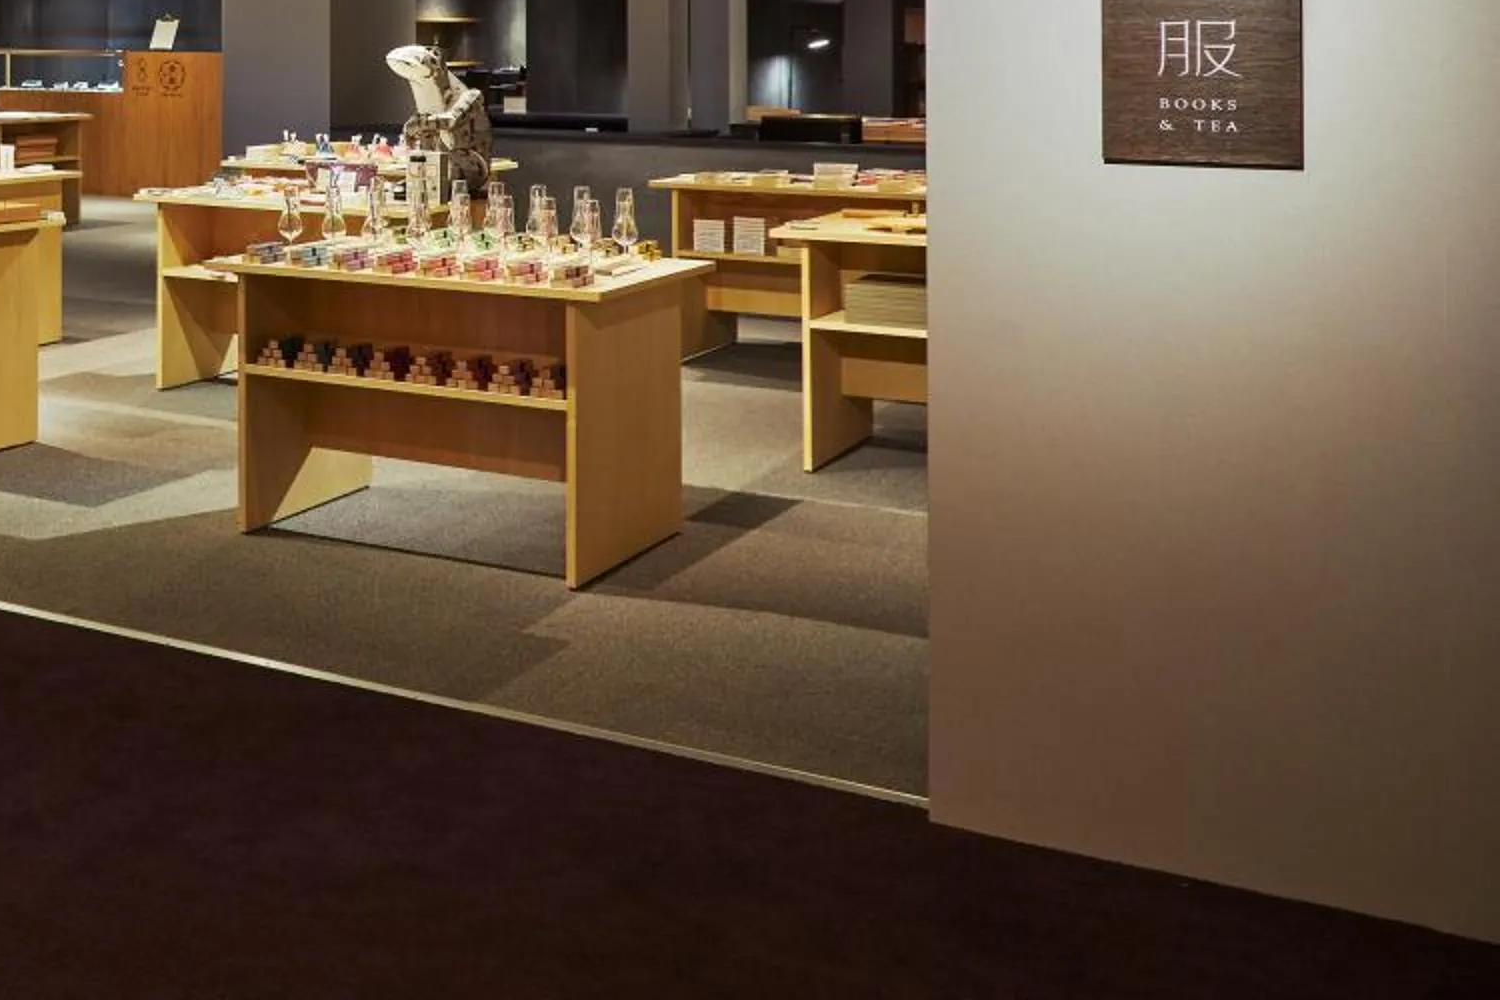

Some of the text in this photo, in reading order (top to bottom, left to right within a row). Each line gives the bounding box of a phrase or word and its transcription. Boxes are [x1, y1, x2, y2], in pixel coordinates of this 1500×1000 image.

[1159, 97, 1237, 111] BOOKS
[1159, 119, 1238, 133] & TEA
